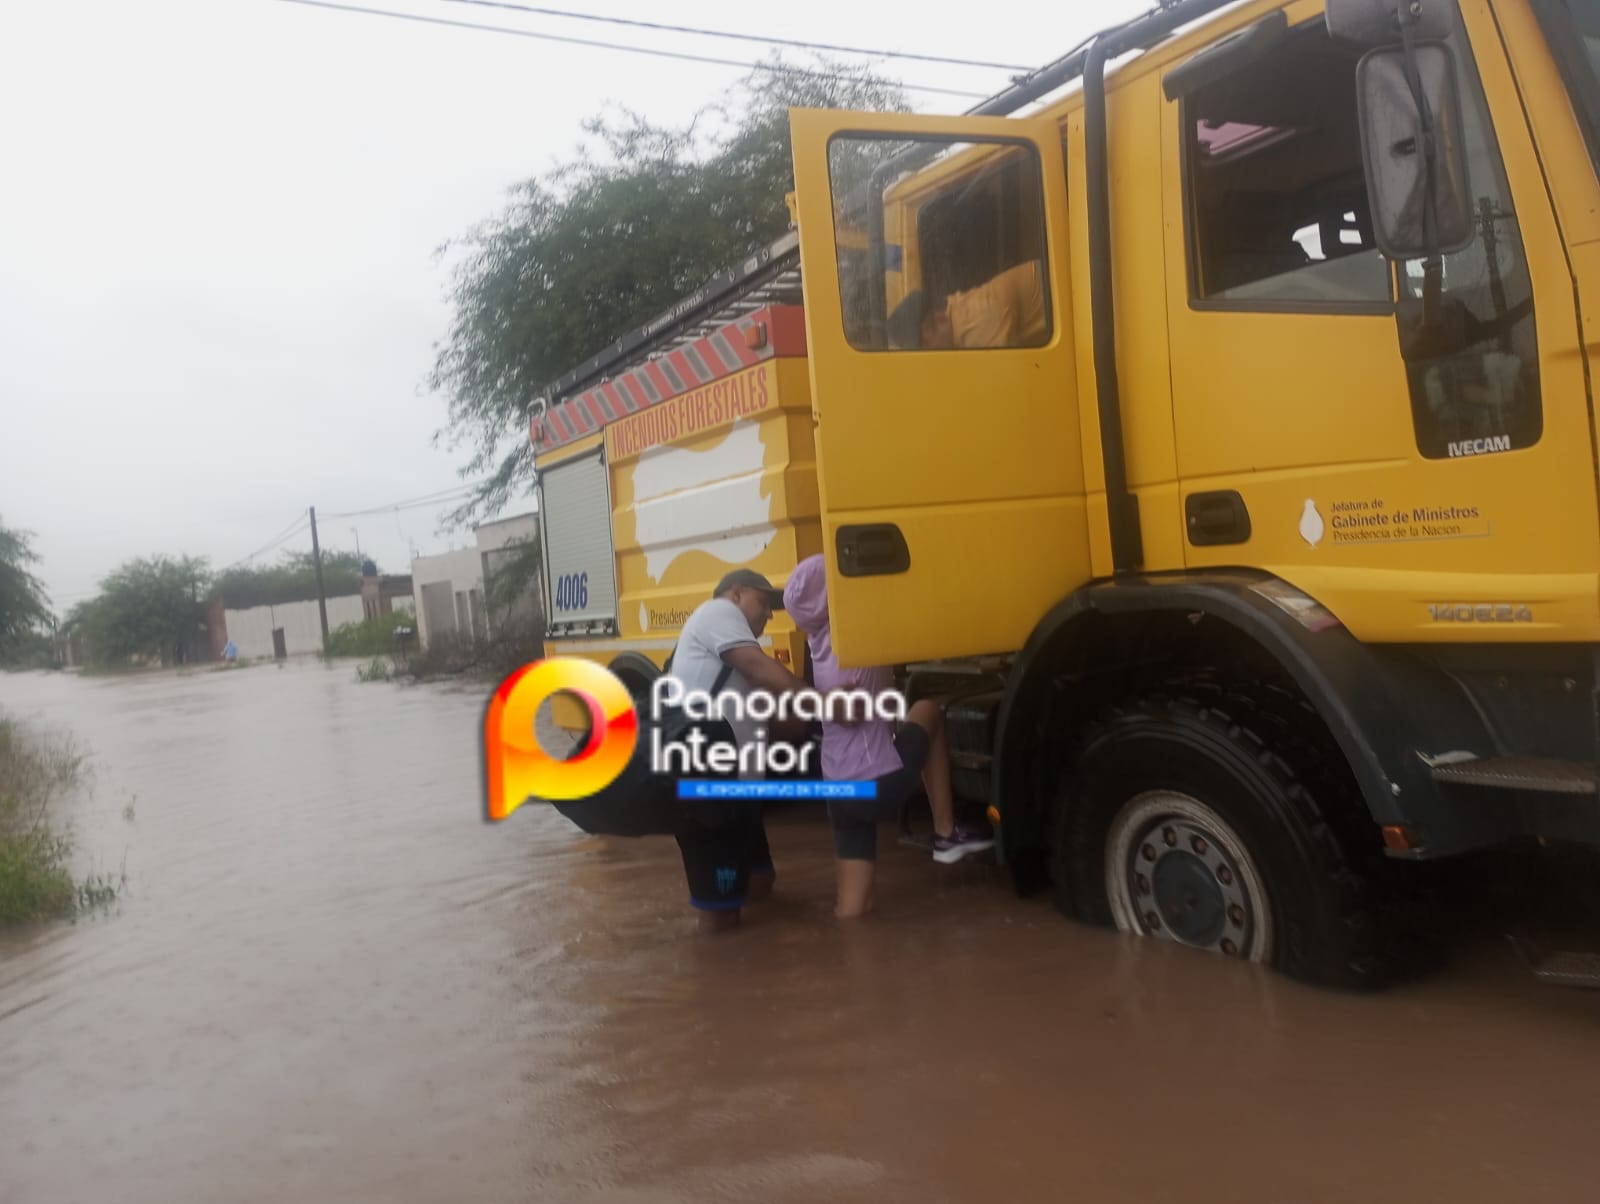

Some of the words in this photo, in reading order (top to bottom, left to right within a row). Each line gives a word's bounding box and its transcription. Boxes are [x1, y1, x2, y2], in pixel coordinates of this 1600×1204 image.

[613, 402, 677, 459] INCENDIOS
[680, 366, 768, 434] FORESTALES
[1448, 434, 1511, 457] IVECAM
[1331, 502, 1368, 512] Jefatura
[1371, 498, 1383, 509] de
[1332, 513, 1389, 529] Gabinete
[1392, 511, 1409, 523] de
[1413, 506, 1479, 522] Ministros
[1333, 528, 1390, 541] Presidencia
[1393, 526, 1407, 537] de
[1409, 525, 1419, 537] la
[556, 571, 588, 611] 4006
